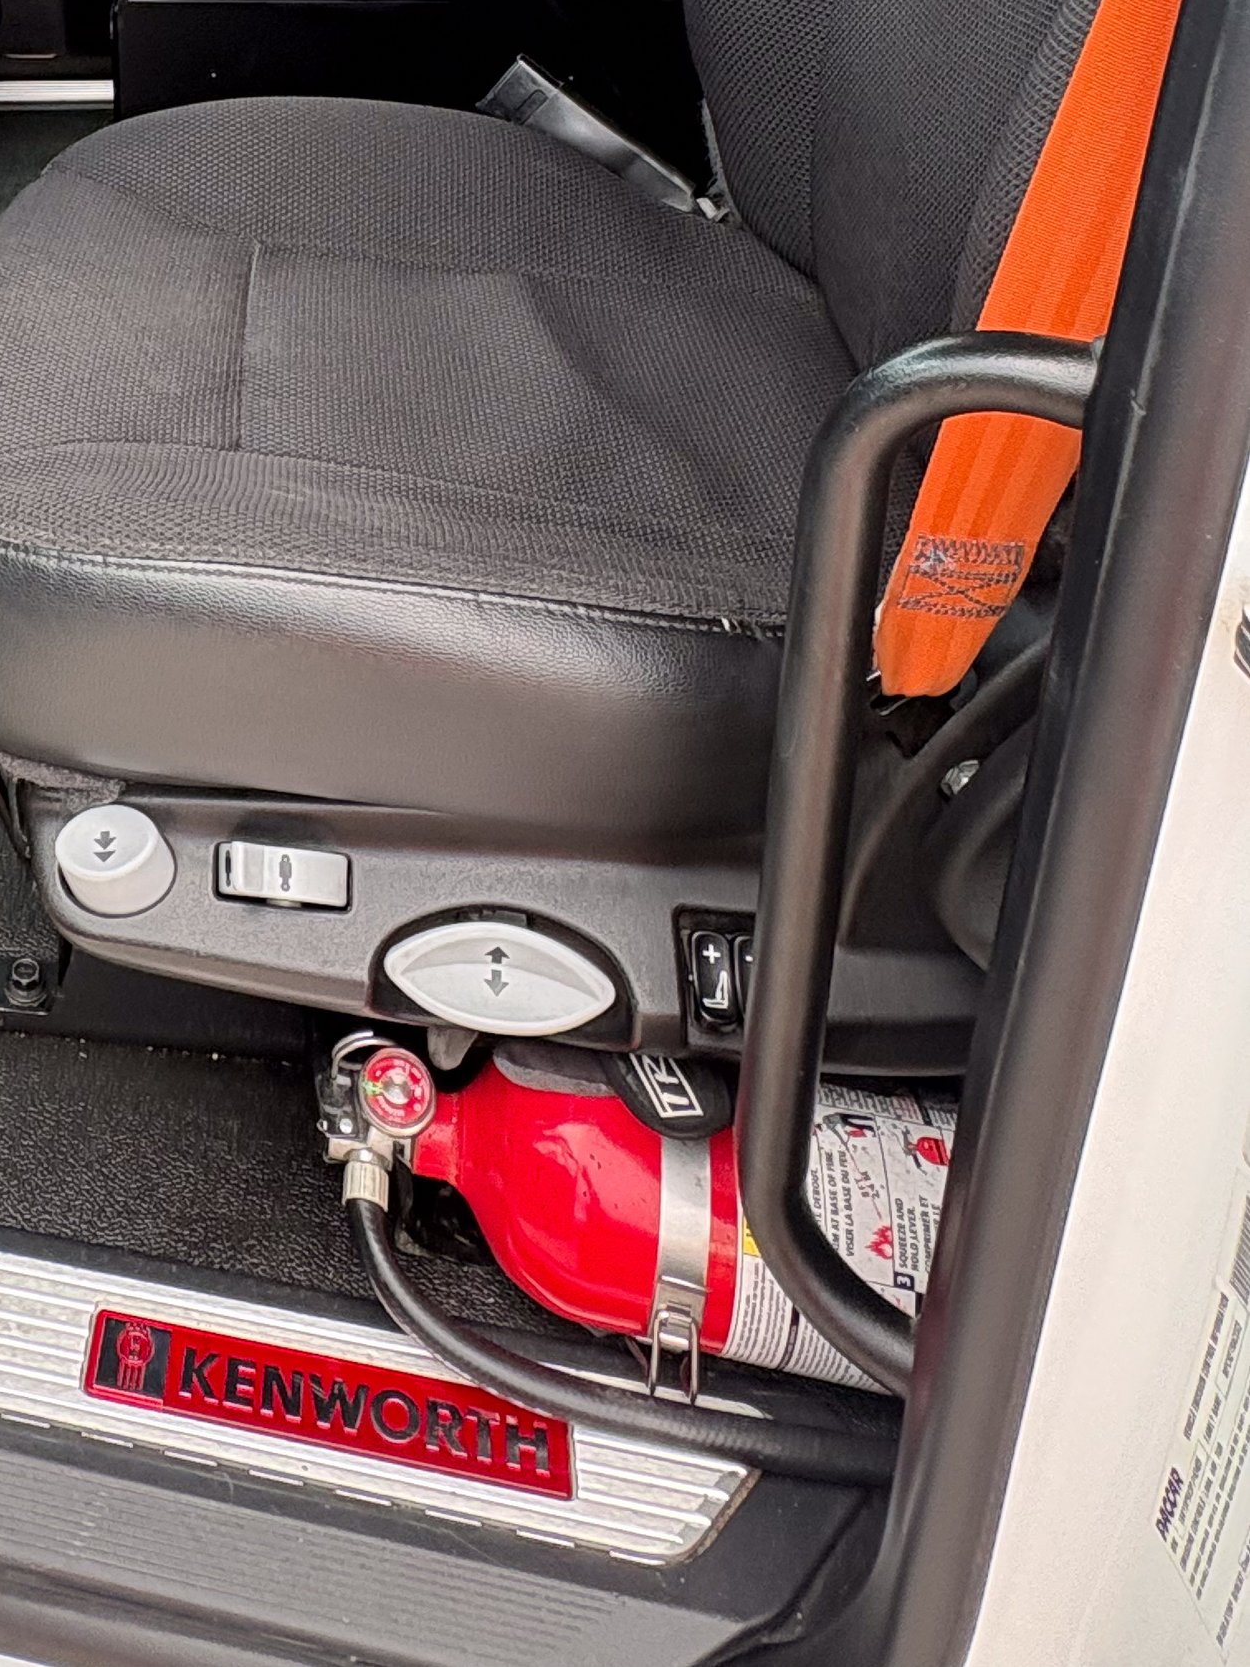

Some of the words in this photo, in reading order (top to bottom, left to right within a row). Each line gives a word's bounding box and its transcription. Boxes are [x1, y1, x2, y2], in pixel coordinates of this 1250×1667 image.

[827, 1171, 837, 1188] OF
[841, 1170, 850, 1185] DU
[829, 1189, 839, 1216] BASE
[843, 1187, 853, 1211] BASE
[894, 1197, 905, 1221] AND
[918, 1195, 930, 1209] ET
[845, 1213, 854, 1227] LA
[845, 1228, 855, 1257] VISER
[897, 1223, 909, 1269] SQUEEZE
[909, 1243, 920, 1272] HOLD
[896, 1276, 911, 1287] 3
[178, 1347, 551, 1477] KENWORTH
[1155, 1466, 1184, 1543] PACCAR
